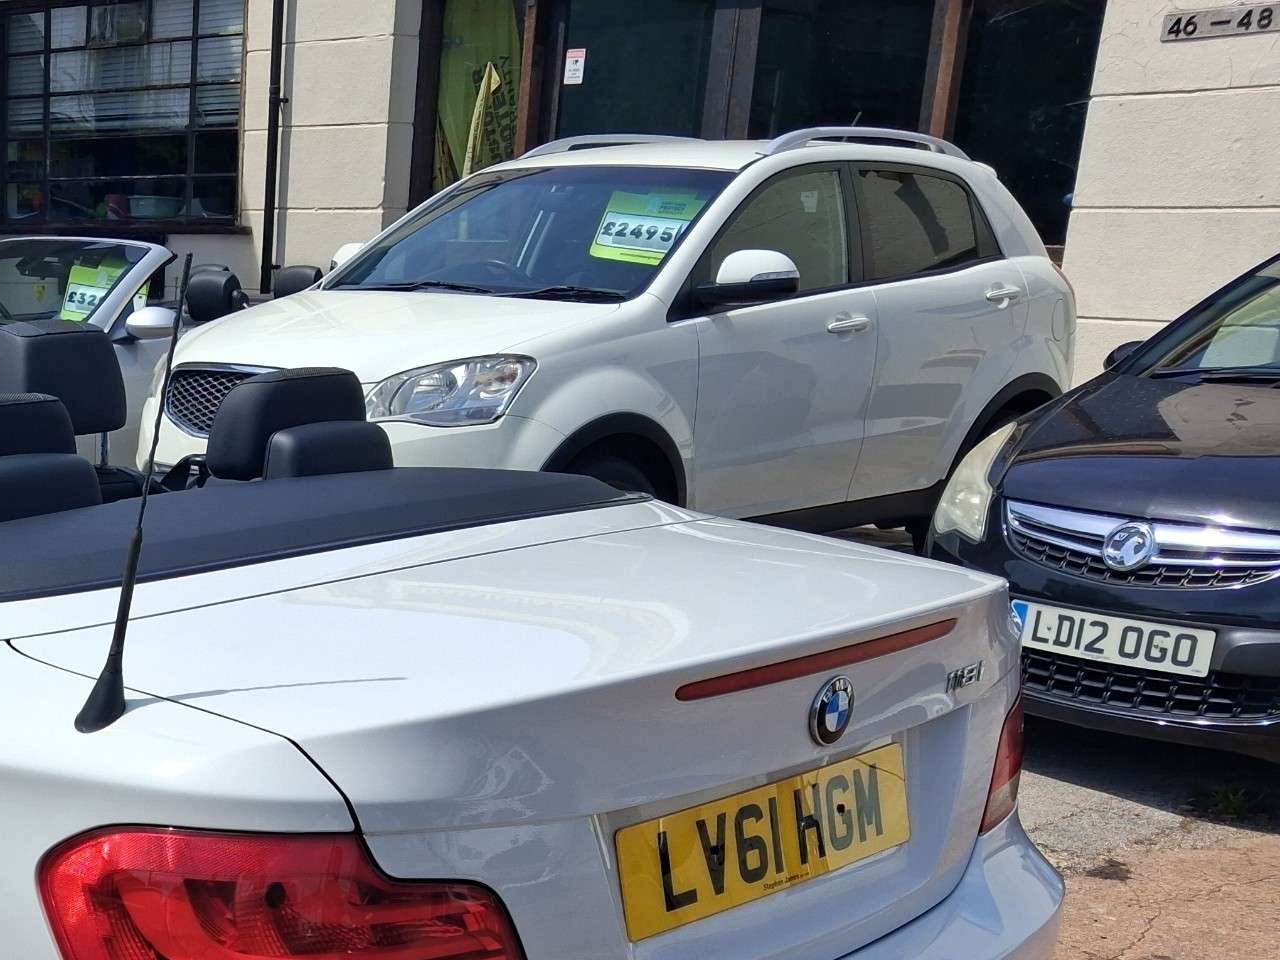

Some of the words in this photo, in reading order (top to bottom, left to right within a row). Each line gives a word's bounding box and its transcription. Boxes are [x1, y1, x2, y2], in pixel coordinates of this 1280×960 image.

[1167, 14, 1198, 37] 46
[1236, 7, 1273, 30] 48
[601, 221, 676, 242] £2495
[1031, 610, 1109, 654] LD12
[1118, 626, 1198, 668] OGO
[657, 797, 785, 912] LV61
[794, 763, 883, 866] HGM
